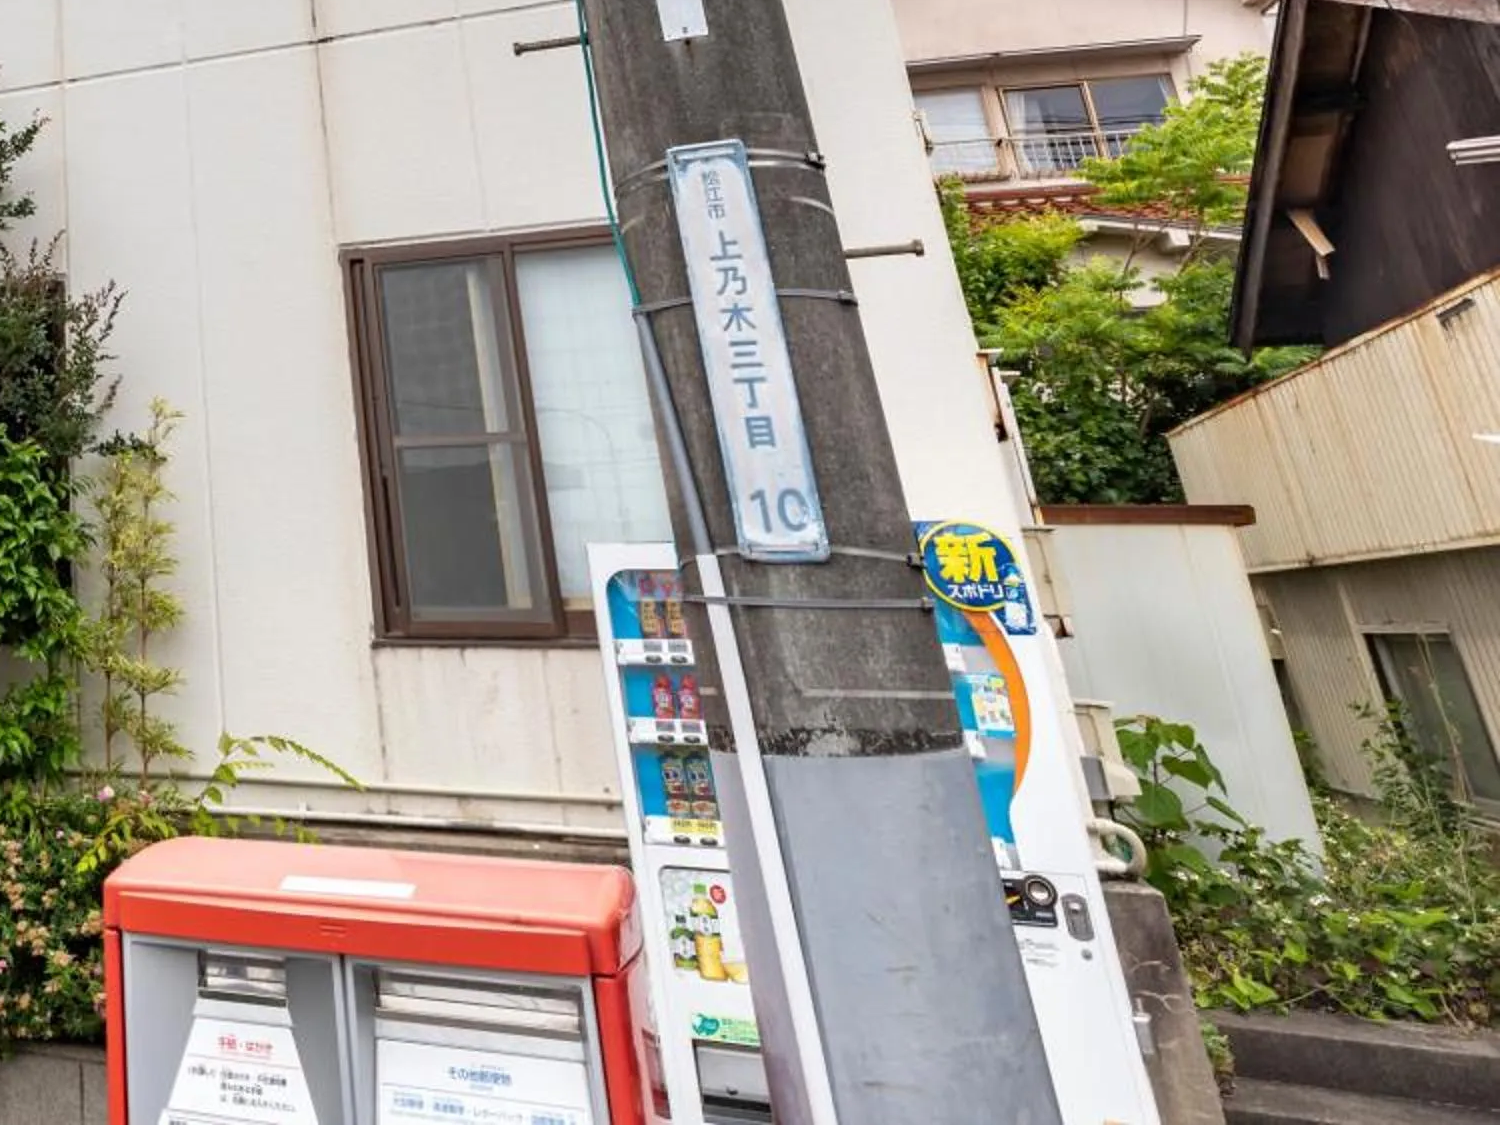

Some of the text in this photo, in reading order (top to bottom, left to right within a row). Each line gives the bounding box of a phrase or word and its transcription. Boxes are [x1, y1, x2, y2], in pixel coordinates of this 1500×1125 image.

[710, 230, 778, 449] 上乃木三丁目
[748, 487, 810, 535] 10
[933, 532, 999, 584] 新
[947, 584, 1004, 600] スポドリ
